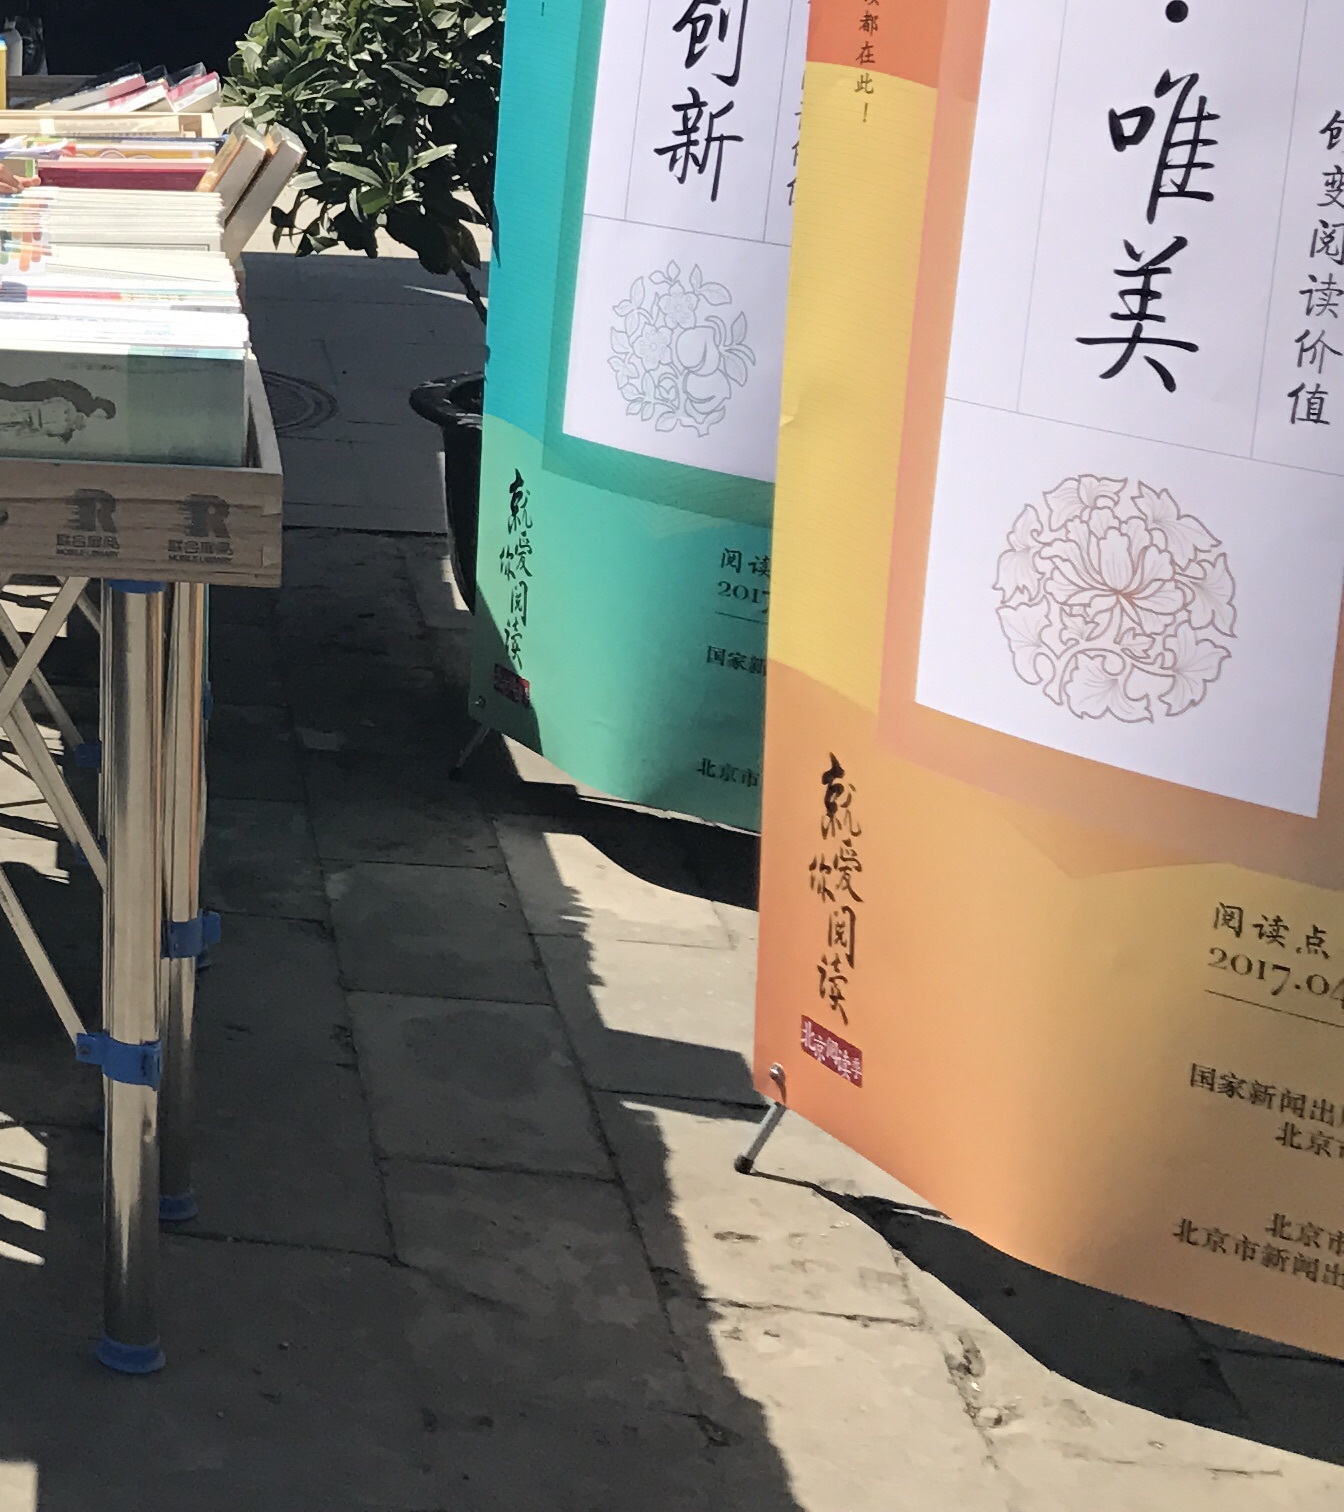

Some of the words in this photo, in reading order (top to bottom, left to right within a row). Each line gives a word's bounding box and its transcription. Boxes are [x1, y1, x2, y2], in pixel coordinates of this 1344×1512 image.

[1213, 901, 1331, 960] 阅读点
[801, 1019, 863, 1081] 北京阅读季
[1189, 1062, 1344, 1128] 国家新闻出
